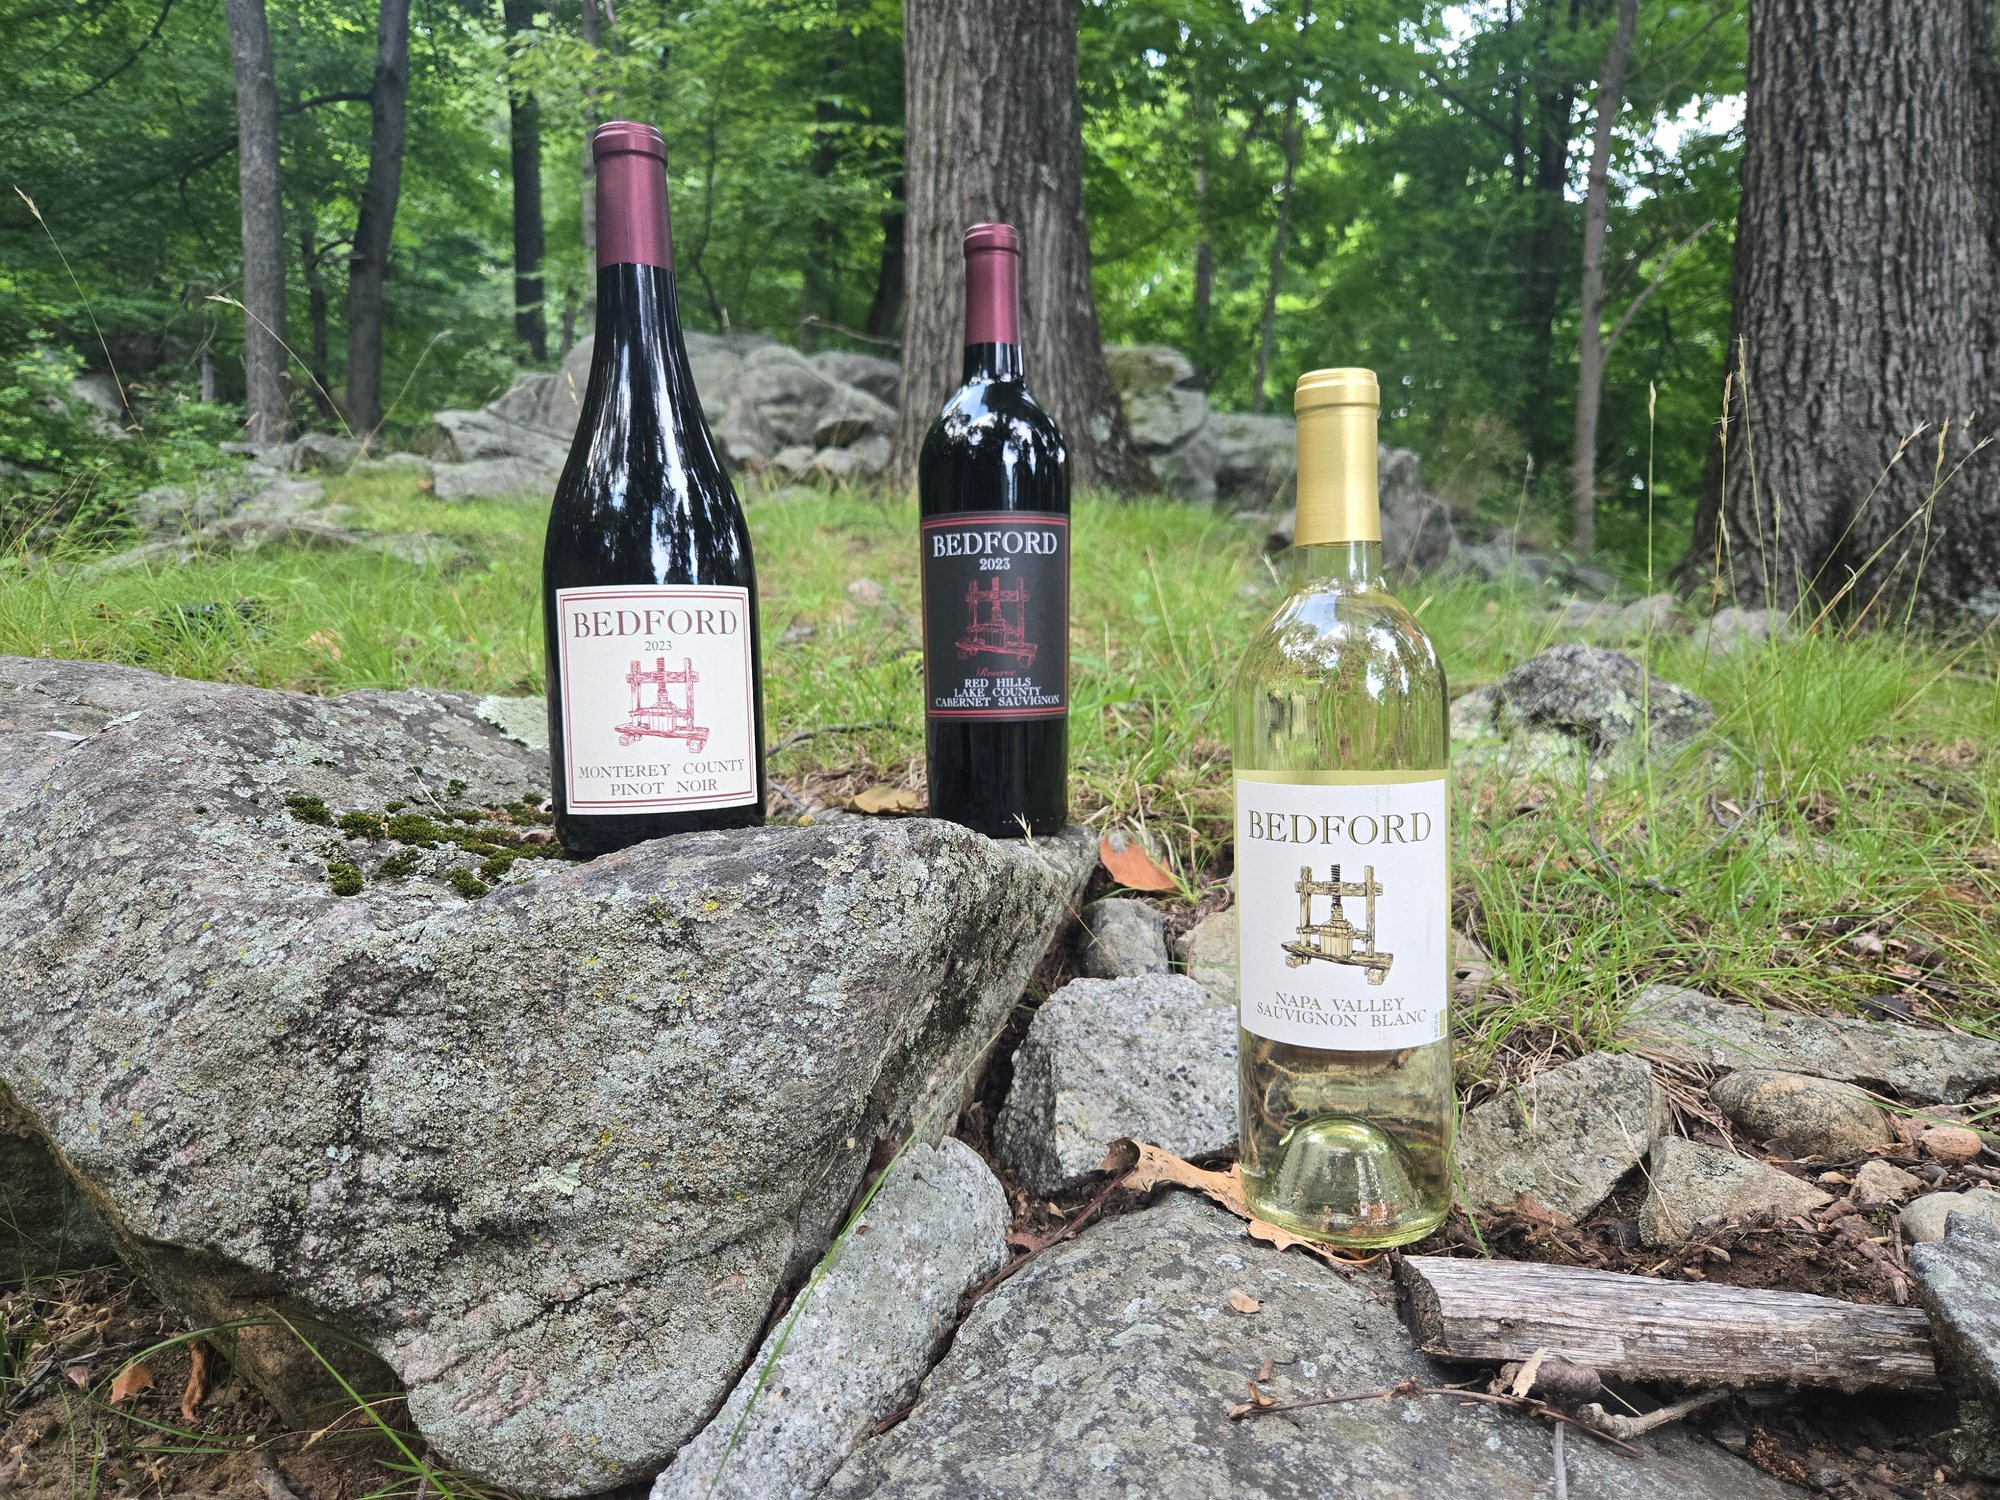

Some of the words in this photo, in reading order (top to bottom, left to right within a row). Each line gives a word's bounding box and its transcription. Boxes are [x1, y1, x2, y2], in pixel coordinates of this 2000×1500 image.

[933, 531, 1058, 558] BEDFORD
[979, 557, 1011, 571] 2023
[573, 609, 737, 638] BEDFORD
[644, 640, 673, 652] 2023
[964, 678, 989, 688] RED
[996, 677, 1031, 687] HILLS
[935, 697, 991, 707] CABERNET
[998, 694, 1060, 706] SAUVIGNON
[954, 688, 985, 698] LAKE
[992, 686, 1041, 697] COUNTY
[578, 763, 671, 779] MONTEREY
[683, 759, 745, 775] COUNTY
[610, 782, 664, 796] PINOT
[676, 779, 718, 793] NOIR
[1248, 809, 1432, 845] BEDFORD
[1275, 991, 1322, 1010] NAPA
[1331, 997, 1406, 1013] VALLEY
[1256, 1002, 1358, 1027] SAUVIGNON
[1371, 1009, 1427, 1028] BLANC
